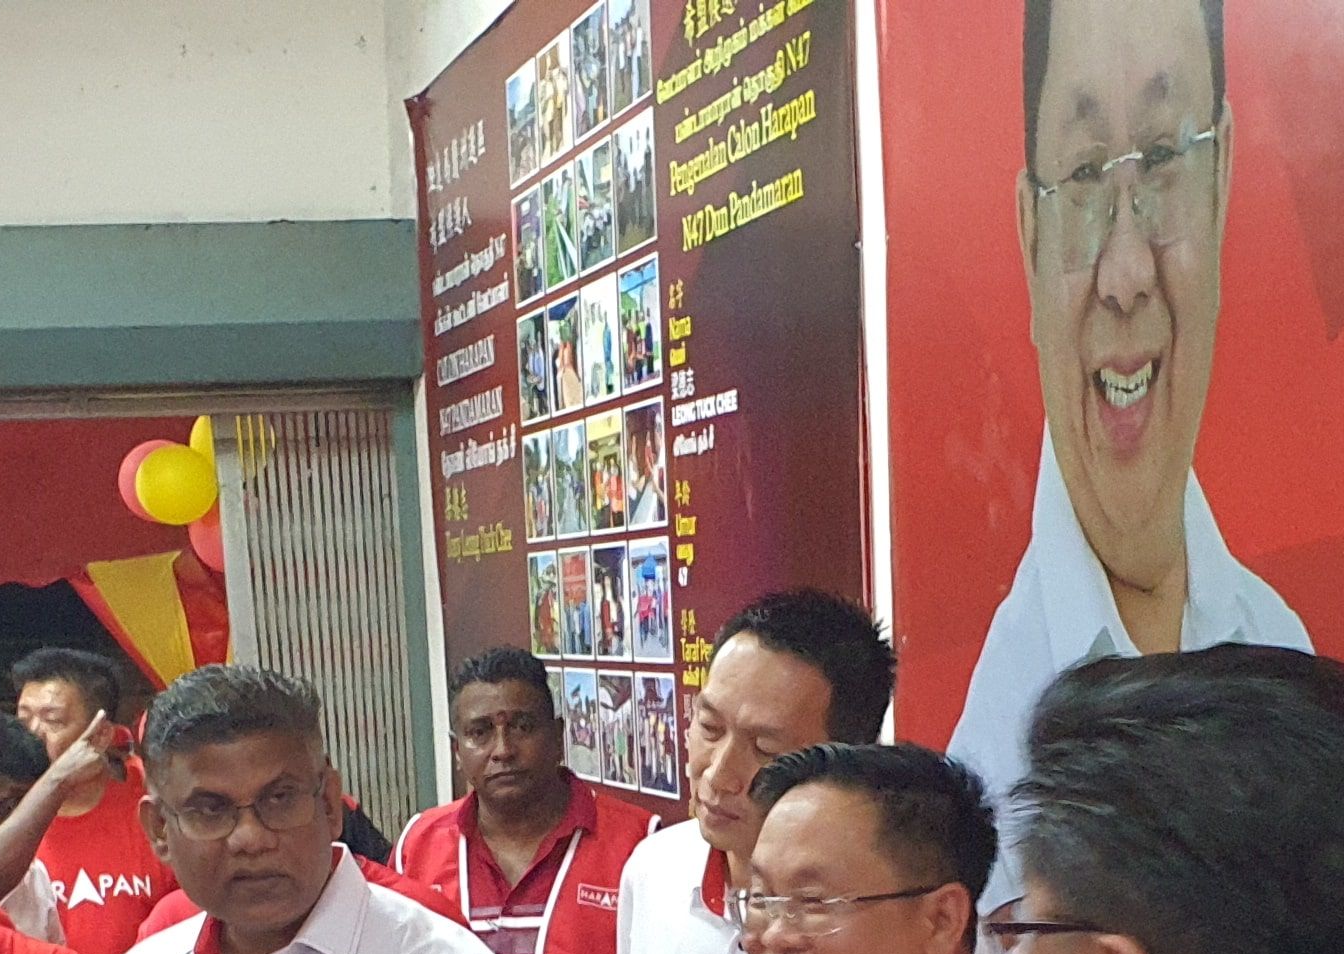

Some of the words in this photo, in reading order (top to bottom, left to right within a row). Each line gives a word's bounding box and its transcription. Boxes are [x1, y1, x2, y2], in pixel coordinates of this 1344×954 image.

[785, 30, 811, 75] N47
[670, 137, 728, 196] Pengenalan
[727, 119, 761, 163] Calon
[760, 89, 816, 140] Harapan
[682, 210, 705, 252] N47
[729, 168, 804, 229] Pandamaran
[669, 316, 691, 341] Nama
[672, 401, 696, 427] LEONG
[696, 395, 717, 420] TUCK
[716, 389, 738, 415] CHEE
[680, 636, 700, 662] Taraf
